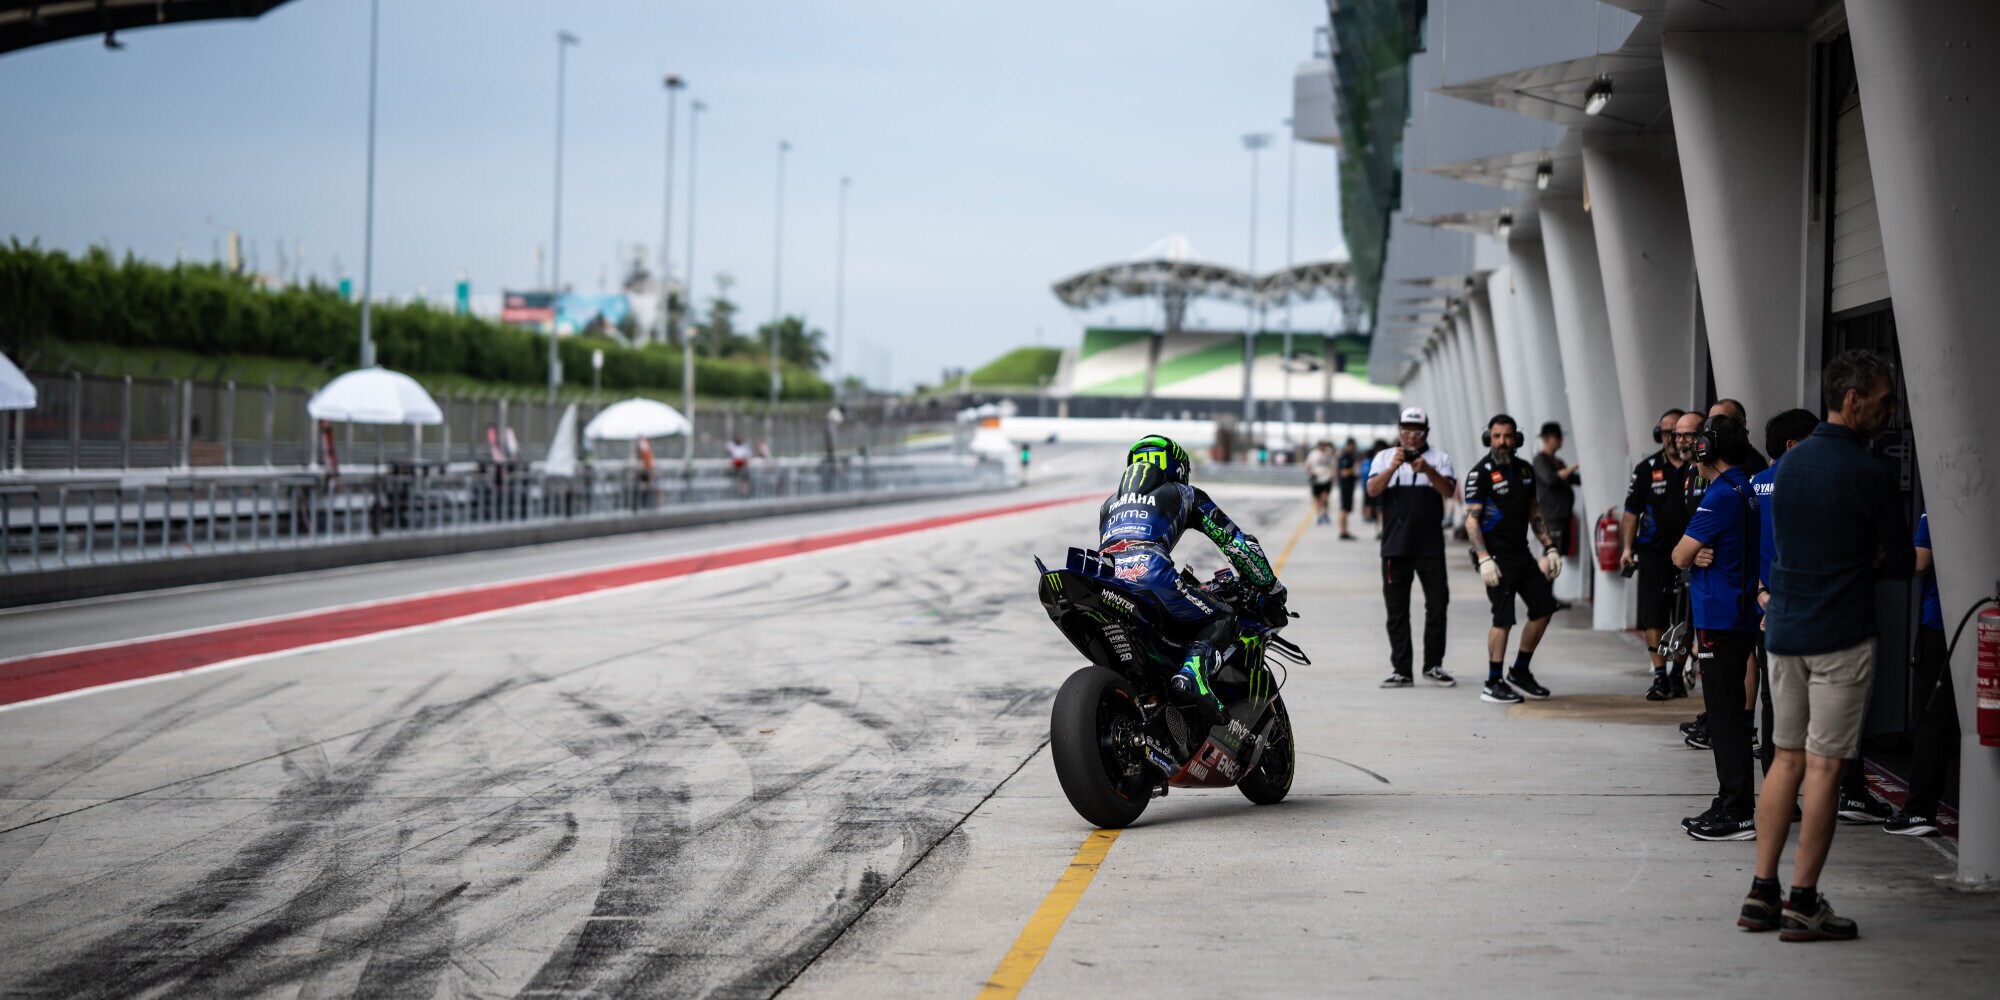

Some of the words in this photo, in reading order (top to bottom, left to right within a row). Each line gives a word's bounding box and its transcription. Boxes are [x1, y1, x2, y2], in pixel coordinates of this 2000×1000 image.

[1108, 492, 1156, 513] YAMAHA
[1107, 509, 1148, 528] prima
[1101, 588, 1135, 613] MONSTER
[1187, 760, 1209, 782] YAMAHA
